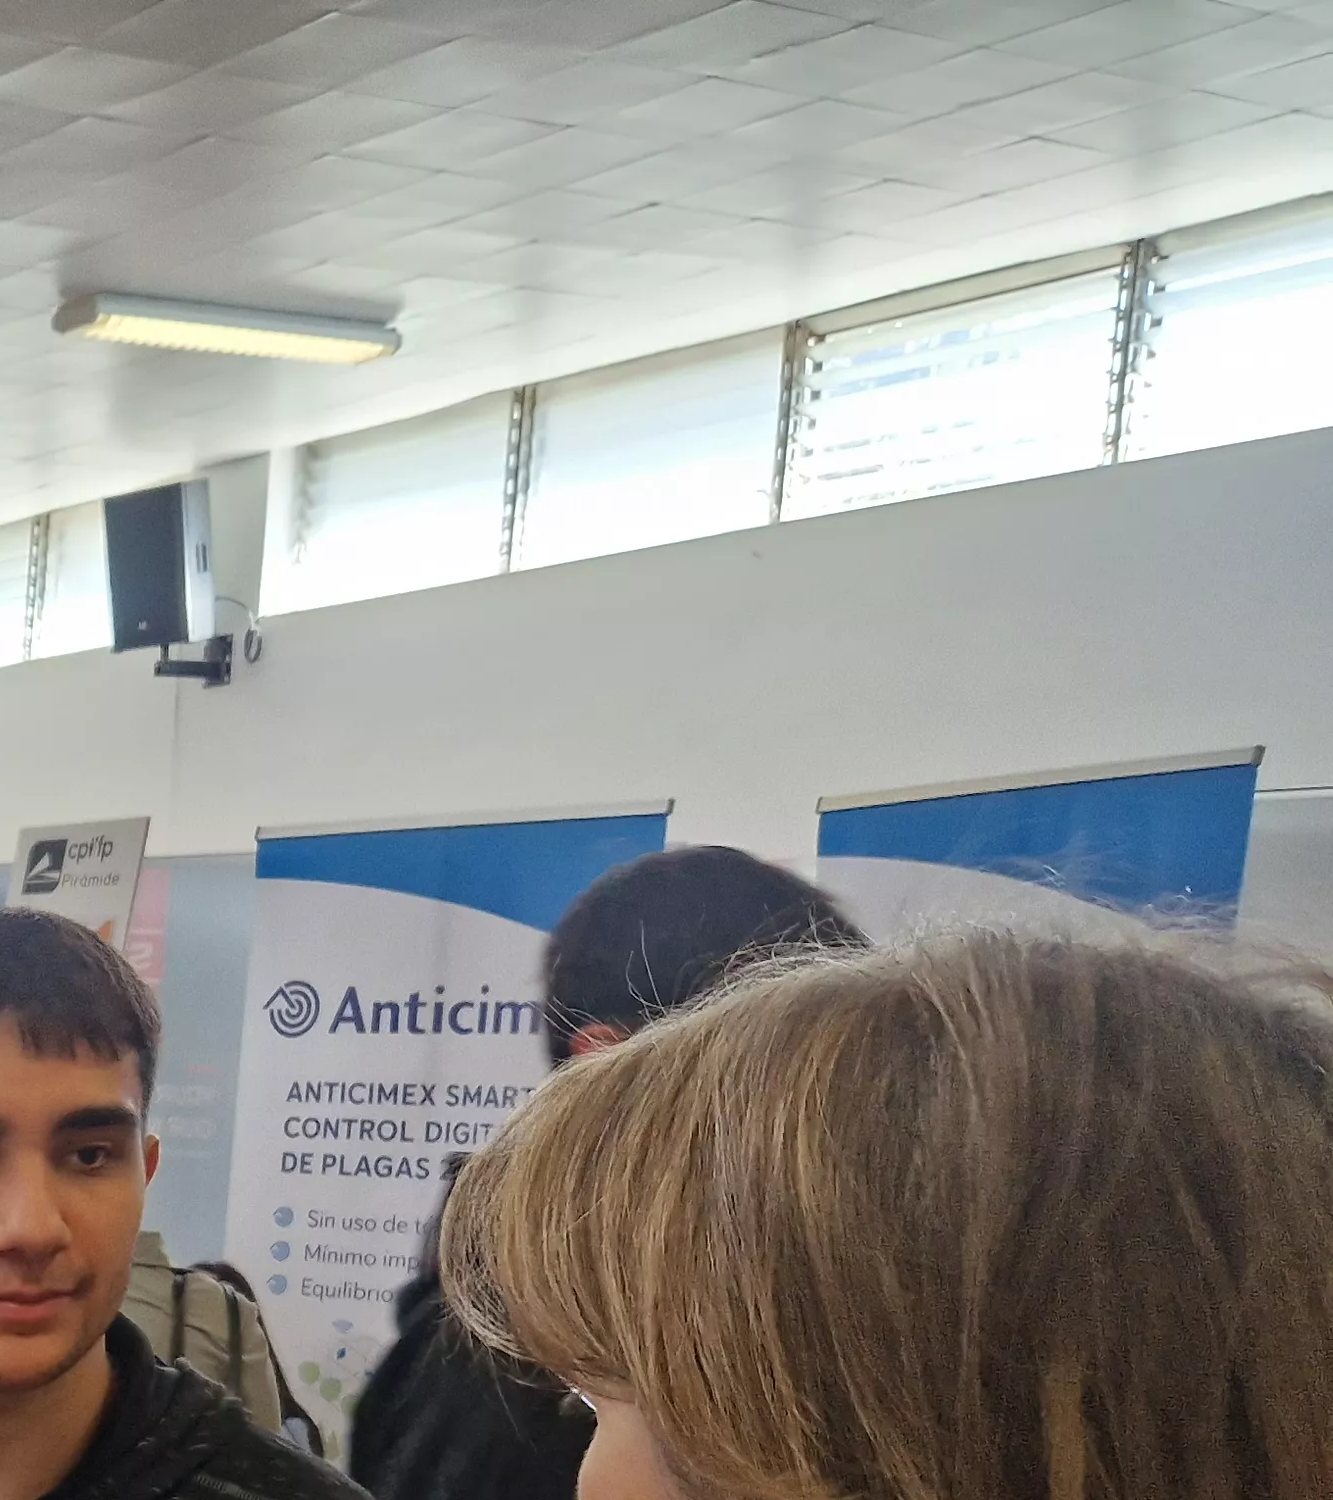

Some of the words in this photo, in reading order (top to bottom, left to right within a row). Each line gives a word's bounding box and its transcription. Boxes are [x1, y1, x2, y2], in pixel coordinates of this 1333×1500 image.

[328, 985, 542, 1035] Anticim
[285, 1080, 436, 1107] ANTICIMEX
[283, 1116, 414, 1142] CONTROL
[424, 1121, 493, 1145] DIGIT
[281, 1151, 314, 1175] DE
[321, 1153, 430, 1180] PLAGAS
[307, 1208, 335, 1230] Sin
[341, 1216, 377, 1232] uso
[383, 1213, 408, 1235] de
[300, 1277, 395, 1303] Equilibrio
